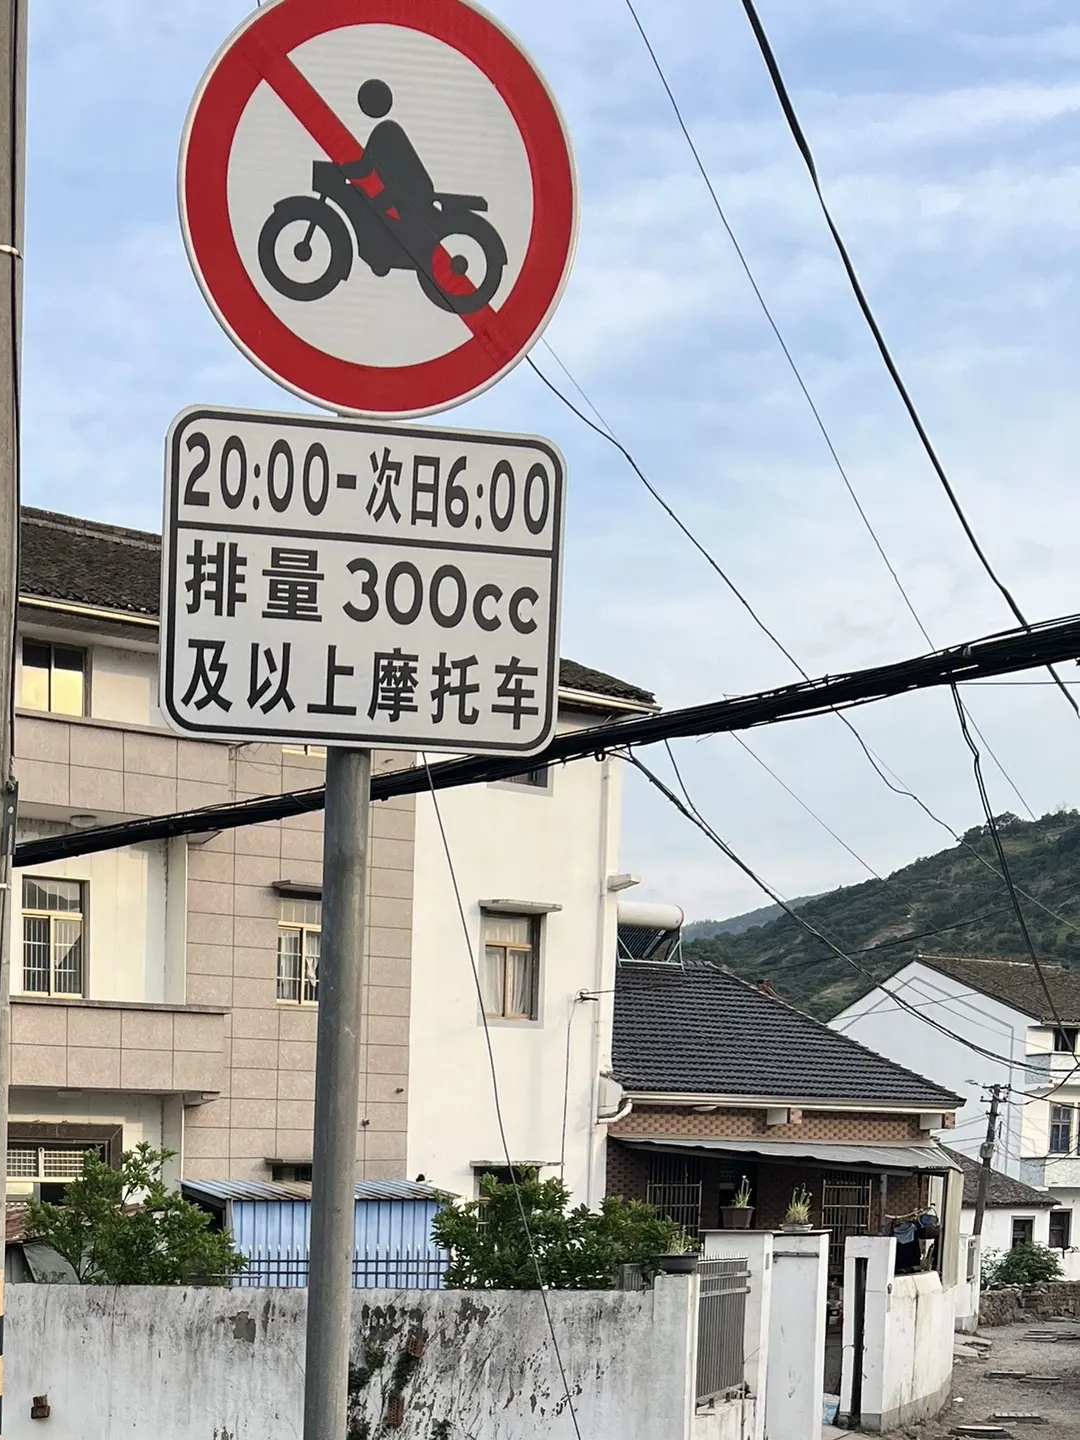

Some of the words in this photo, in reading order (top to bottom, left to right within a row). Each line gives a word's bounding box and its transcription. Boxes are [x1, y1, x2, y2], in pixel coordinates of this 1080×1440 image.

[184, 432, 550, 535] 20:00-次日6:00
[180, 638, 539, 730] 及以上摩托车
